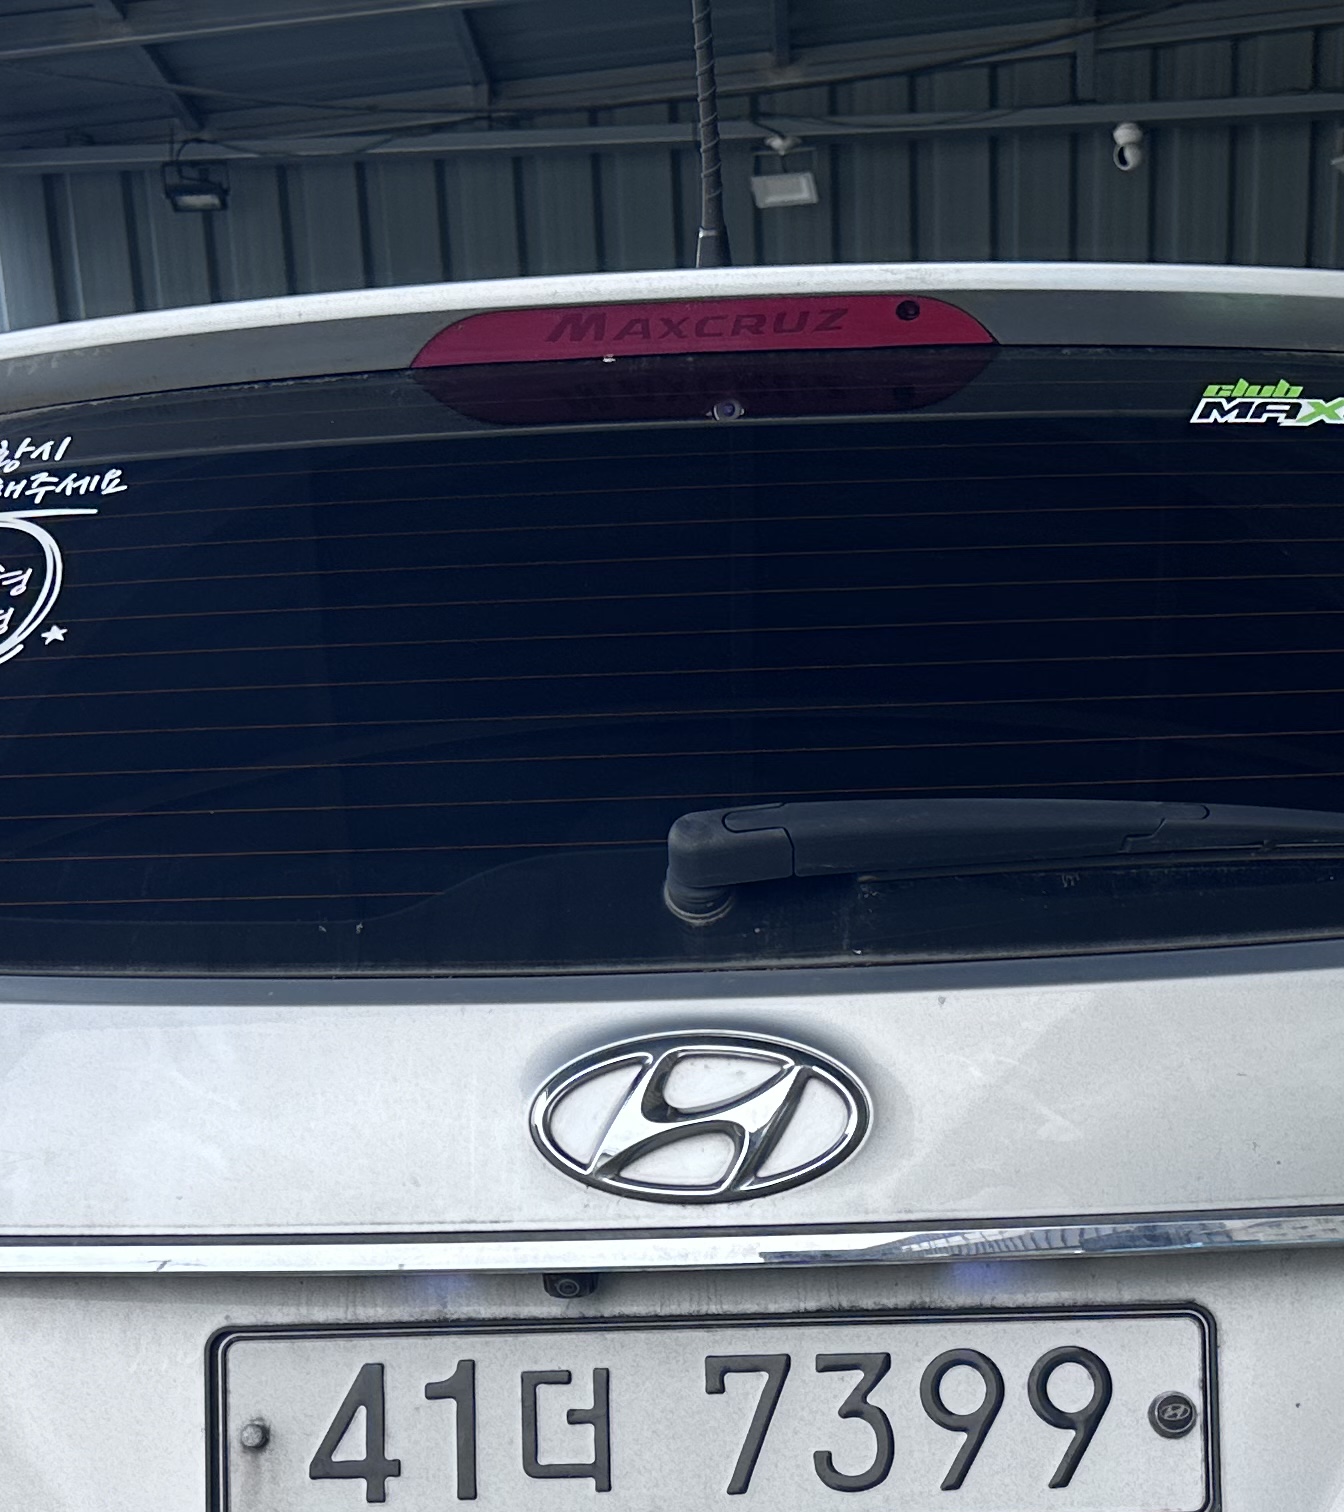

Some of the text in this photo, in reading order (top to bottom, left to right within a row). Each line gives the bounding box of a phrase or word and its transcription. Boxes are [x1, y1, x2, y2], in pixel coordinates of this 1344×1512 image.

[545, 307, 849, 342] MAXCRUZ
[1202, 378, 1304, 398] club
[308, 1344, 1115, 1503] 41더 7399
